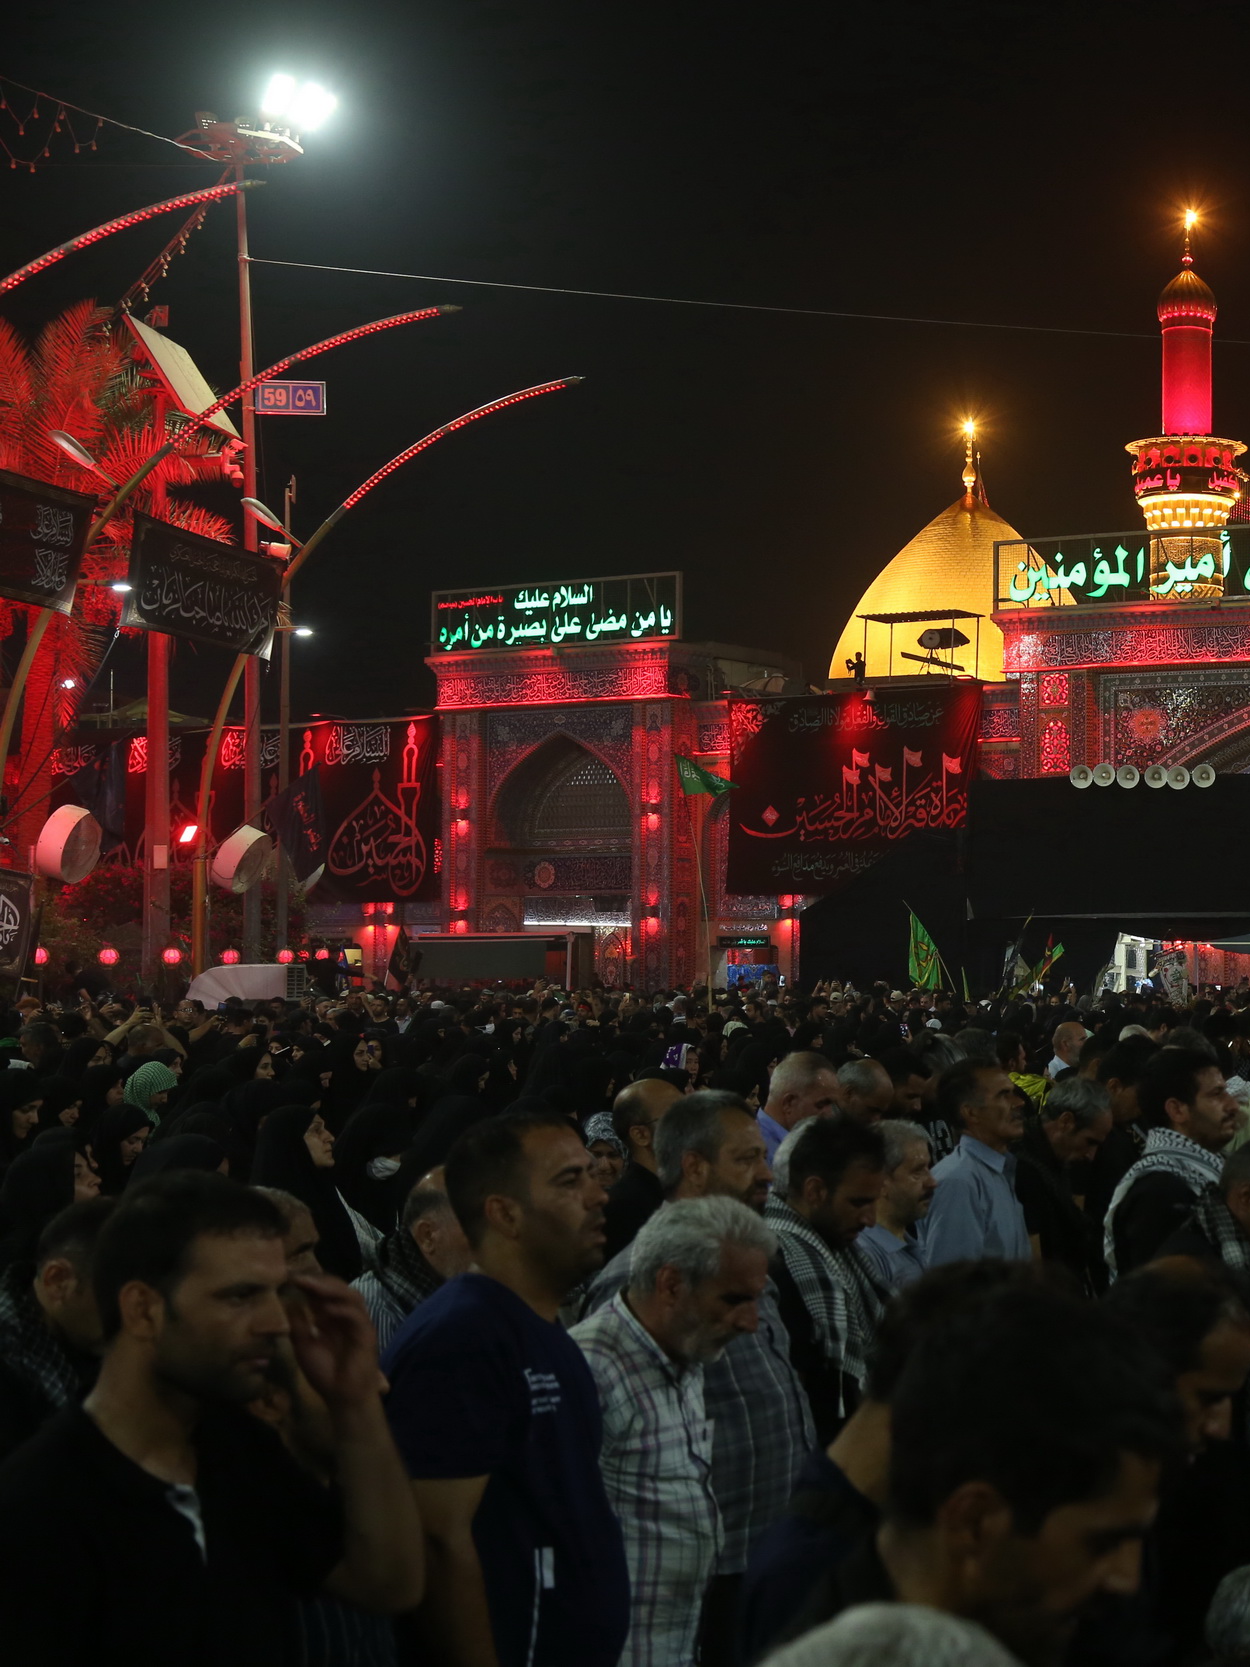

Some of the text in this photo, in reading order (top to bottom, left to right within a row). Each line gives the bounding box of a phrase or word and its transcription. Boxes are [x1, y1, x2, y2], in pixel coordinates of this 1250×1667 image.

[263, 388, 287, 406] 59
[294, 388, 317, 407] ٥٩
[1009, 545, 1145, 602] المؤمنين
[1155, 532, 1231, 592] أمير
[514, 584, 593, 615] السلام عليك
[439, 613, 469, 650] أمره
[497, 615, 547, 646] بصيرة
[631, 611, 655, 638] من
[660, 604, 672, 633] يا
[471, 624, 494, 648] من
